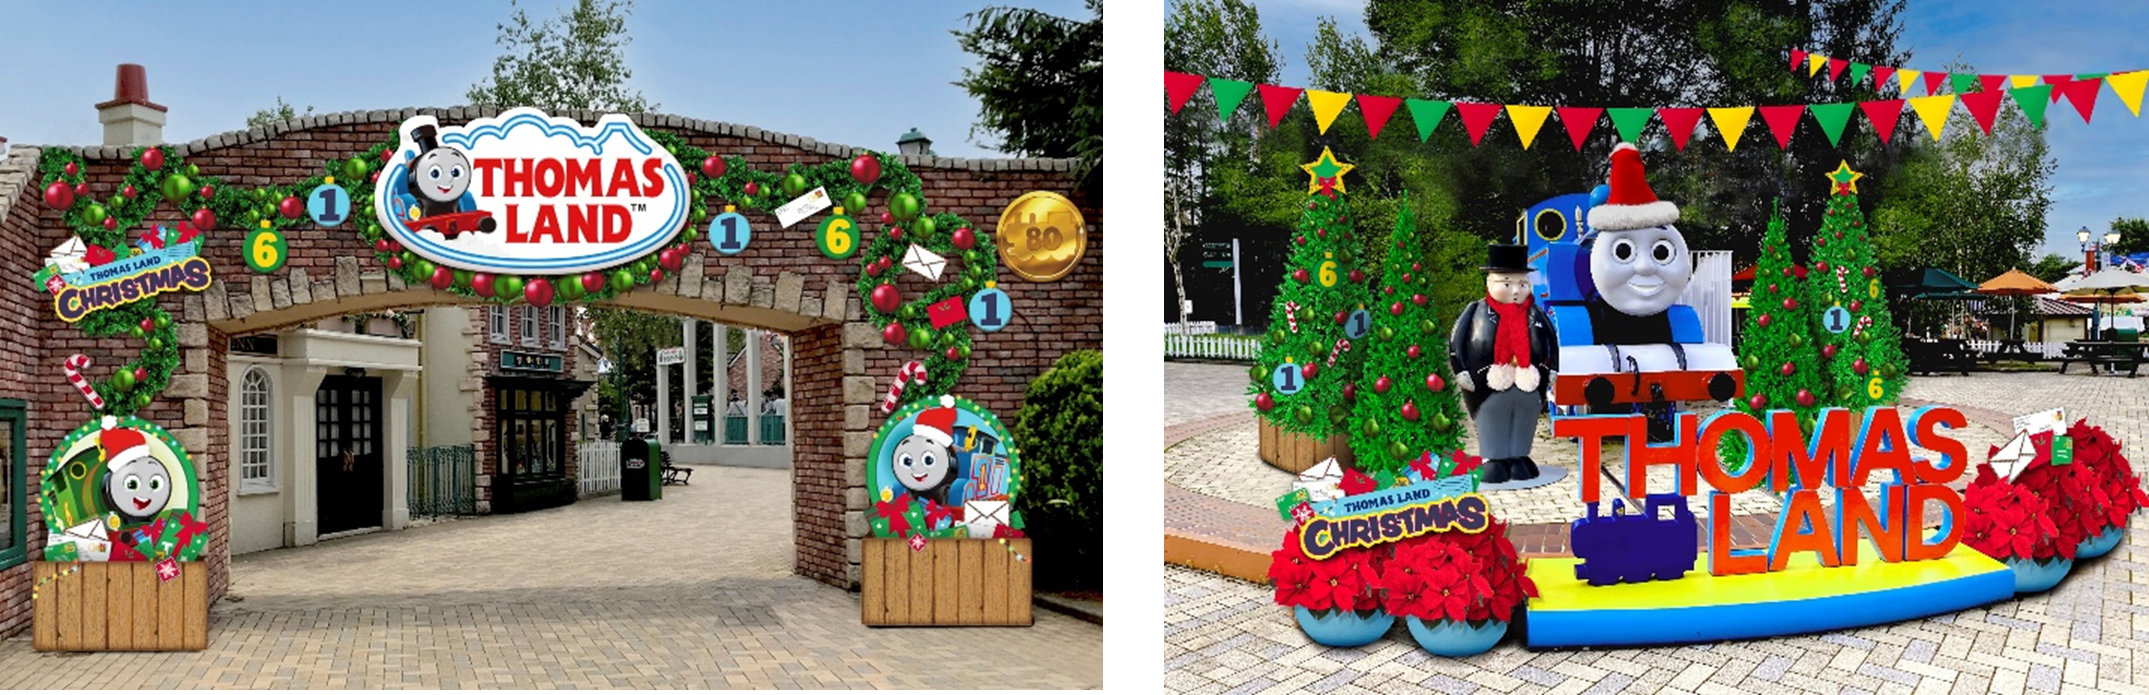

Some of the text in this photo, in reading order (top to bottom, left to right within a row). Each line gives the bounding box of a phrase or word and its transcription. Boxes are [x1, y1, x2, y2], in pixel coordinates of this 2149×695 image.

[473, 157, 665, 198] THOMAS
[319, 189, 340, 221] 1
[505, 204, 632, 243] LAND
[720, 217, 741, 249] 1
[825, 219, 851, 255] 6
[1026, 226, 1063, 251] 80
[253, 232, 278, 267] 6
[90, 256, 161, 281] THOMAS LAND
[1319, 262, 1337, 287] 6
[58, 260, 209, 319] CHRISTMAS
[1869, 278, 1879, 297] 6
[980, 293, 1001, 326] 1
[1354, 312, 1366, 336] 1
[1830, 309, 1843, 330] 1
[1281, 367, 1297, 390] 1
[1868, 377, 1883, 399] 6
[1554, 405, 1968, 502] THOMAS
[1344, 489, 1430, 512] THOMAS LAND
[1304, 497, 1486, 554] CHRISTMAS
[1708, 481, 1966, 576] LAND
